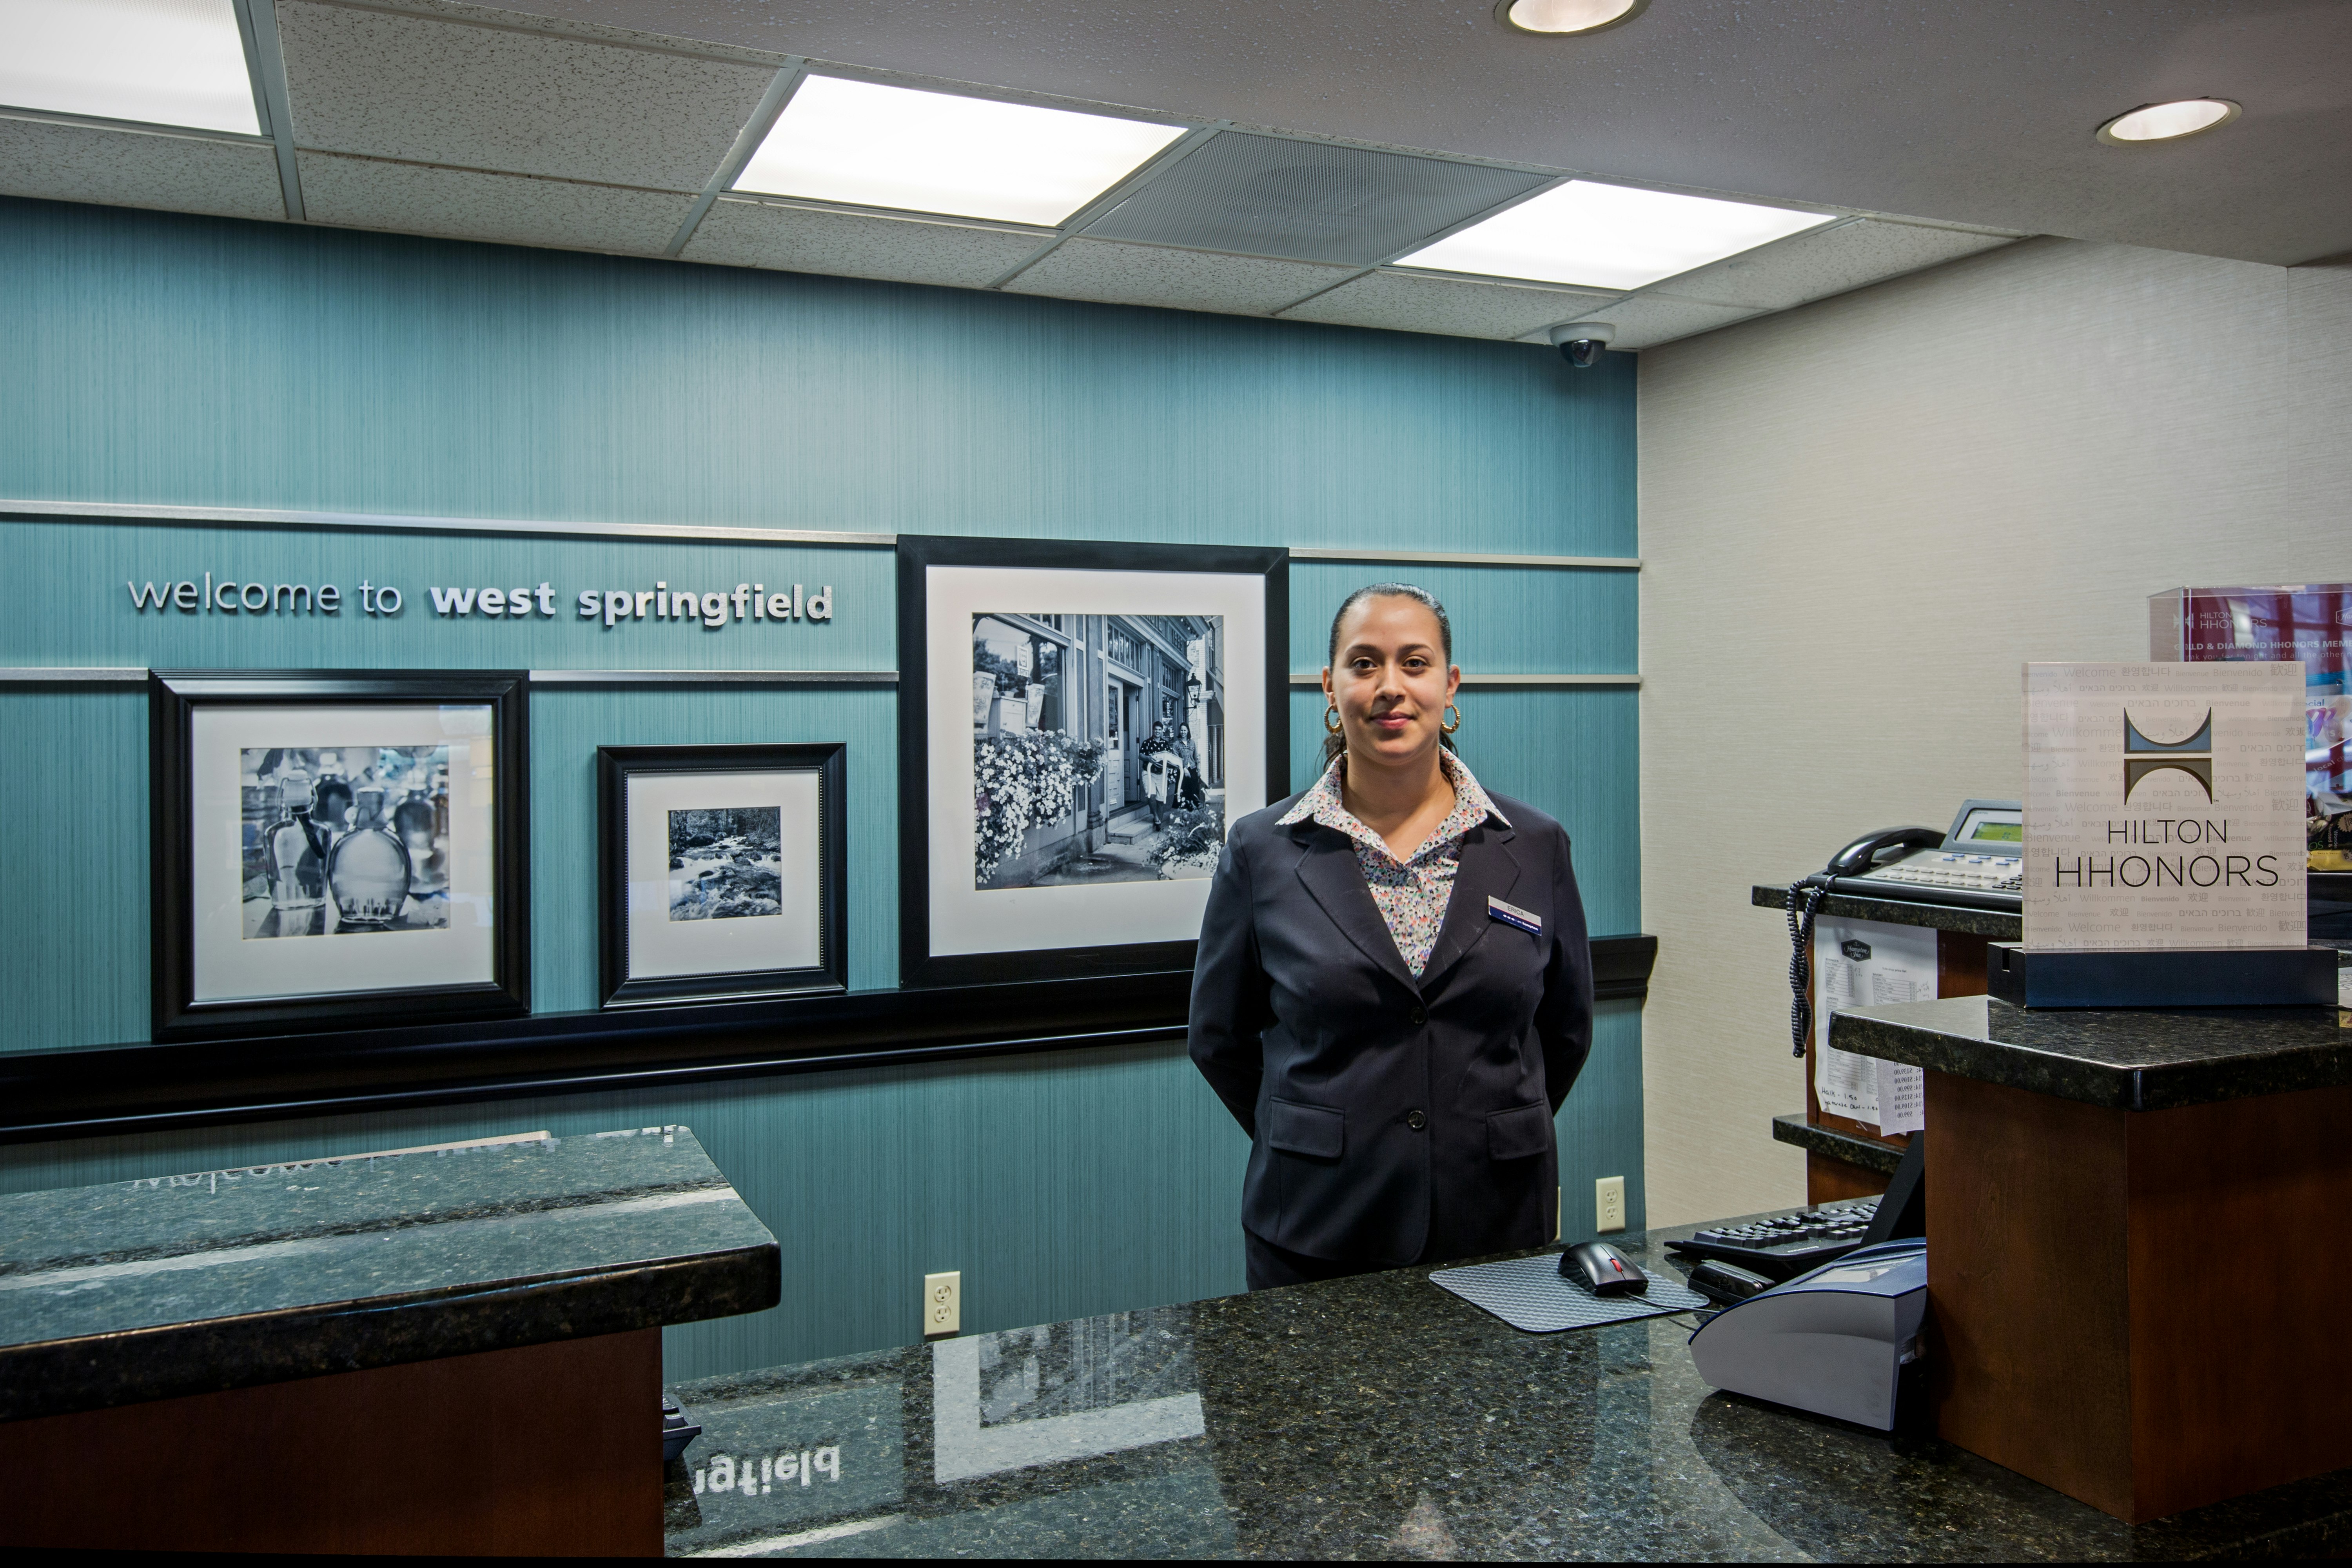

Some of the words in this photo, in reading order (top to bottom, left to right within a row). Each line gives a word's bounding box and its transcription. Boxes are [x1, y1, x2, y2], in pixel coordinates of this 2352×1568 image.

[128, 572, 341, 611] welcome
[359, 580, 402, 613] to
[430, 582, 556, 615] west
[579, 582, 832, 626] springfield
[2200, 619, 2267, 629] HHONRS
[2108, 819, 2227, 844] HILTON
[2056, 855, 2278, 887] HHONORS
[1507, 906, 1524, 916] ERICA
[1844, 945, 1869, 954] Hampton
